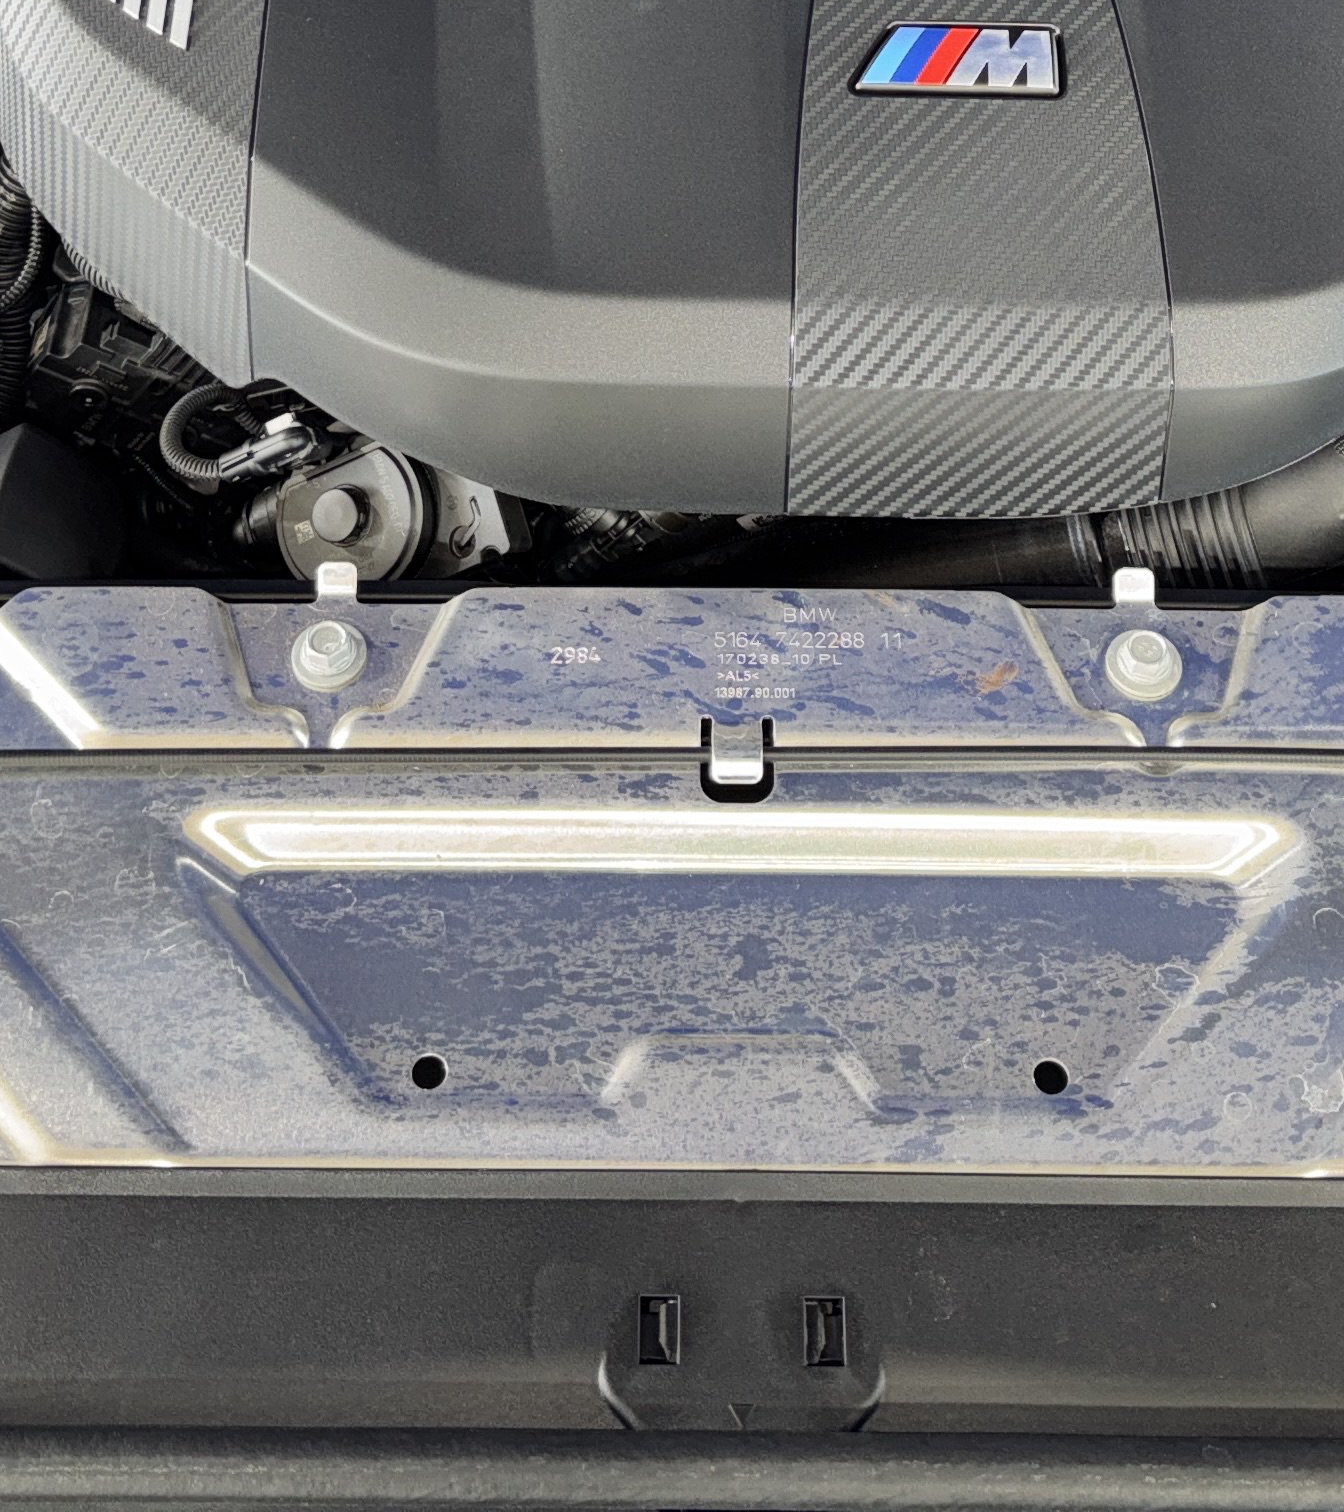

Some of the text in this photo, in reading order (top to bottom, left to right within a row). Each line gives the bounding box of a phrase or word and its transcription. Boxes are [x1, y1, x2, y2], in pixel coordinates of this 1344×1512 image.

[950, 29, 1057, 88] M
[783, 606, 837, 623] BMW
[713, 631, 903, 650] 5164 7422288 11
[550, 646, 601, 665] 2984
[818, 653, 843, 666] PL
[713, 686, 797, 699] 13987.90.001
